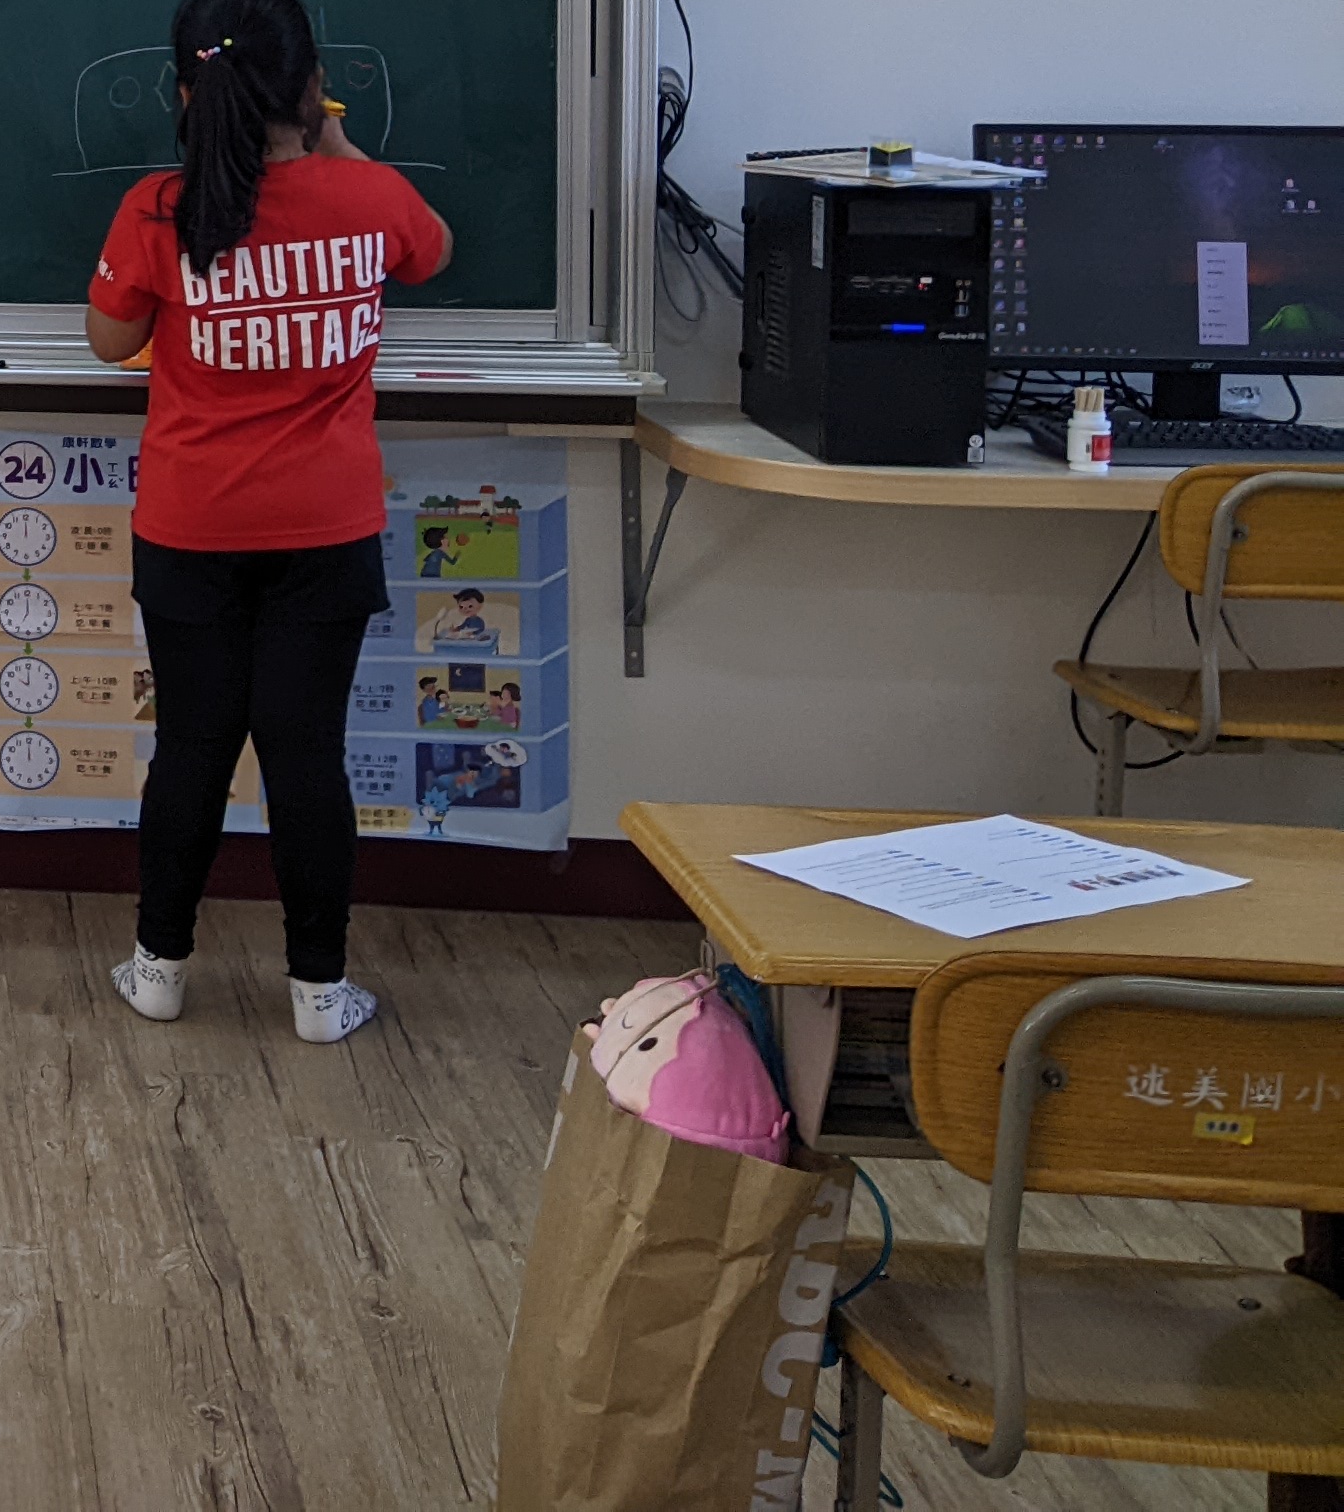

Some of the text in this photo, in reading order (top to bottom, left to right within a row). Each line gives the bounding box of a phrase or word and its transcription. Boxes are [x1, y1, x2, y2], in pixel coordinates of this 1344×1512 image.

[181, 232, 387, 307] BEAUTIFUL
[62, 437, 117, 449] 康軒數學
[4, 453, 104, 493] 24 小
